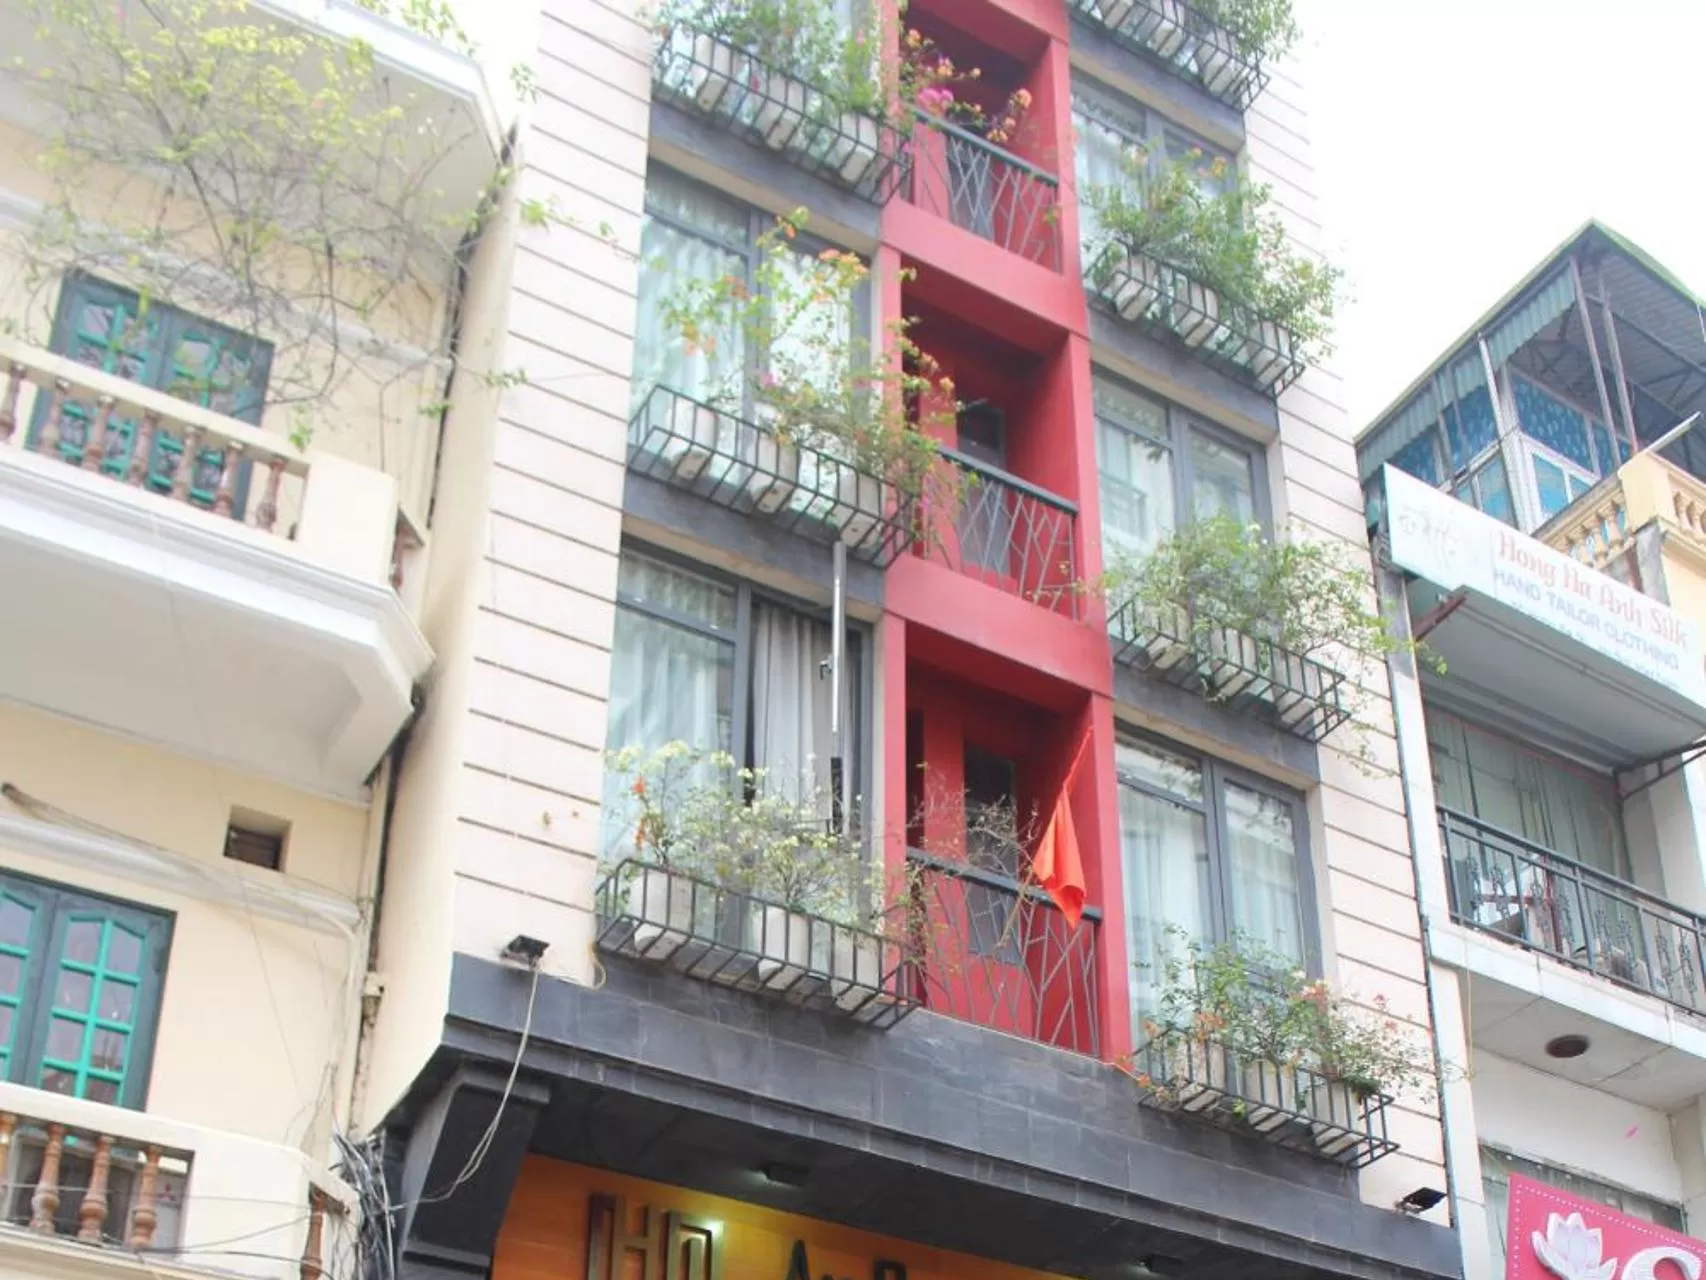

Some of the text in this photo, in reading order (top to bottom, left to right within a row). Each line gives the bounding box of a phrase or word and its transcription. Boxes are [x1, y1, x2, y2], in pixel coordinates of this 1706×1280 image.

[1546, 590, 1605, 633] TAILOR
[1604, 620, 1680, 671] CLOTHING
[1650, 607, 1689, 650] Silk
